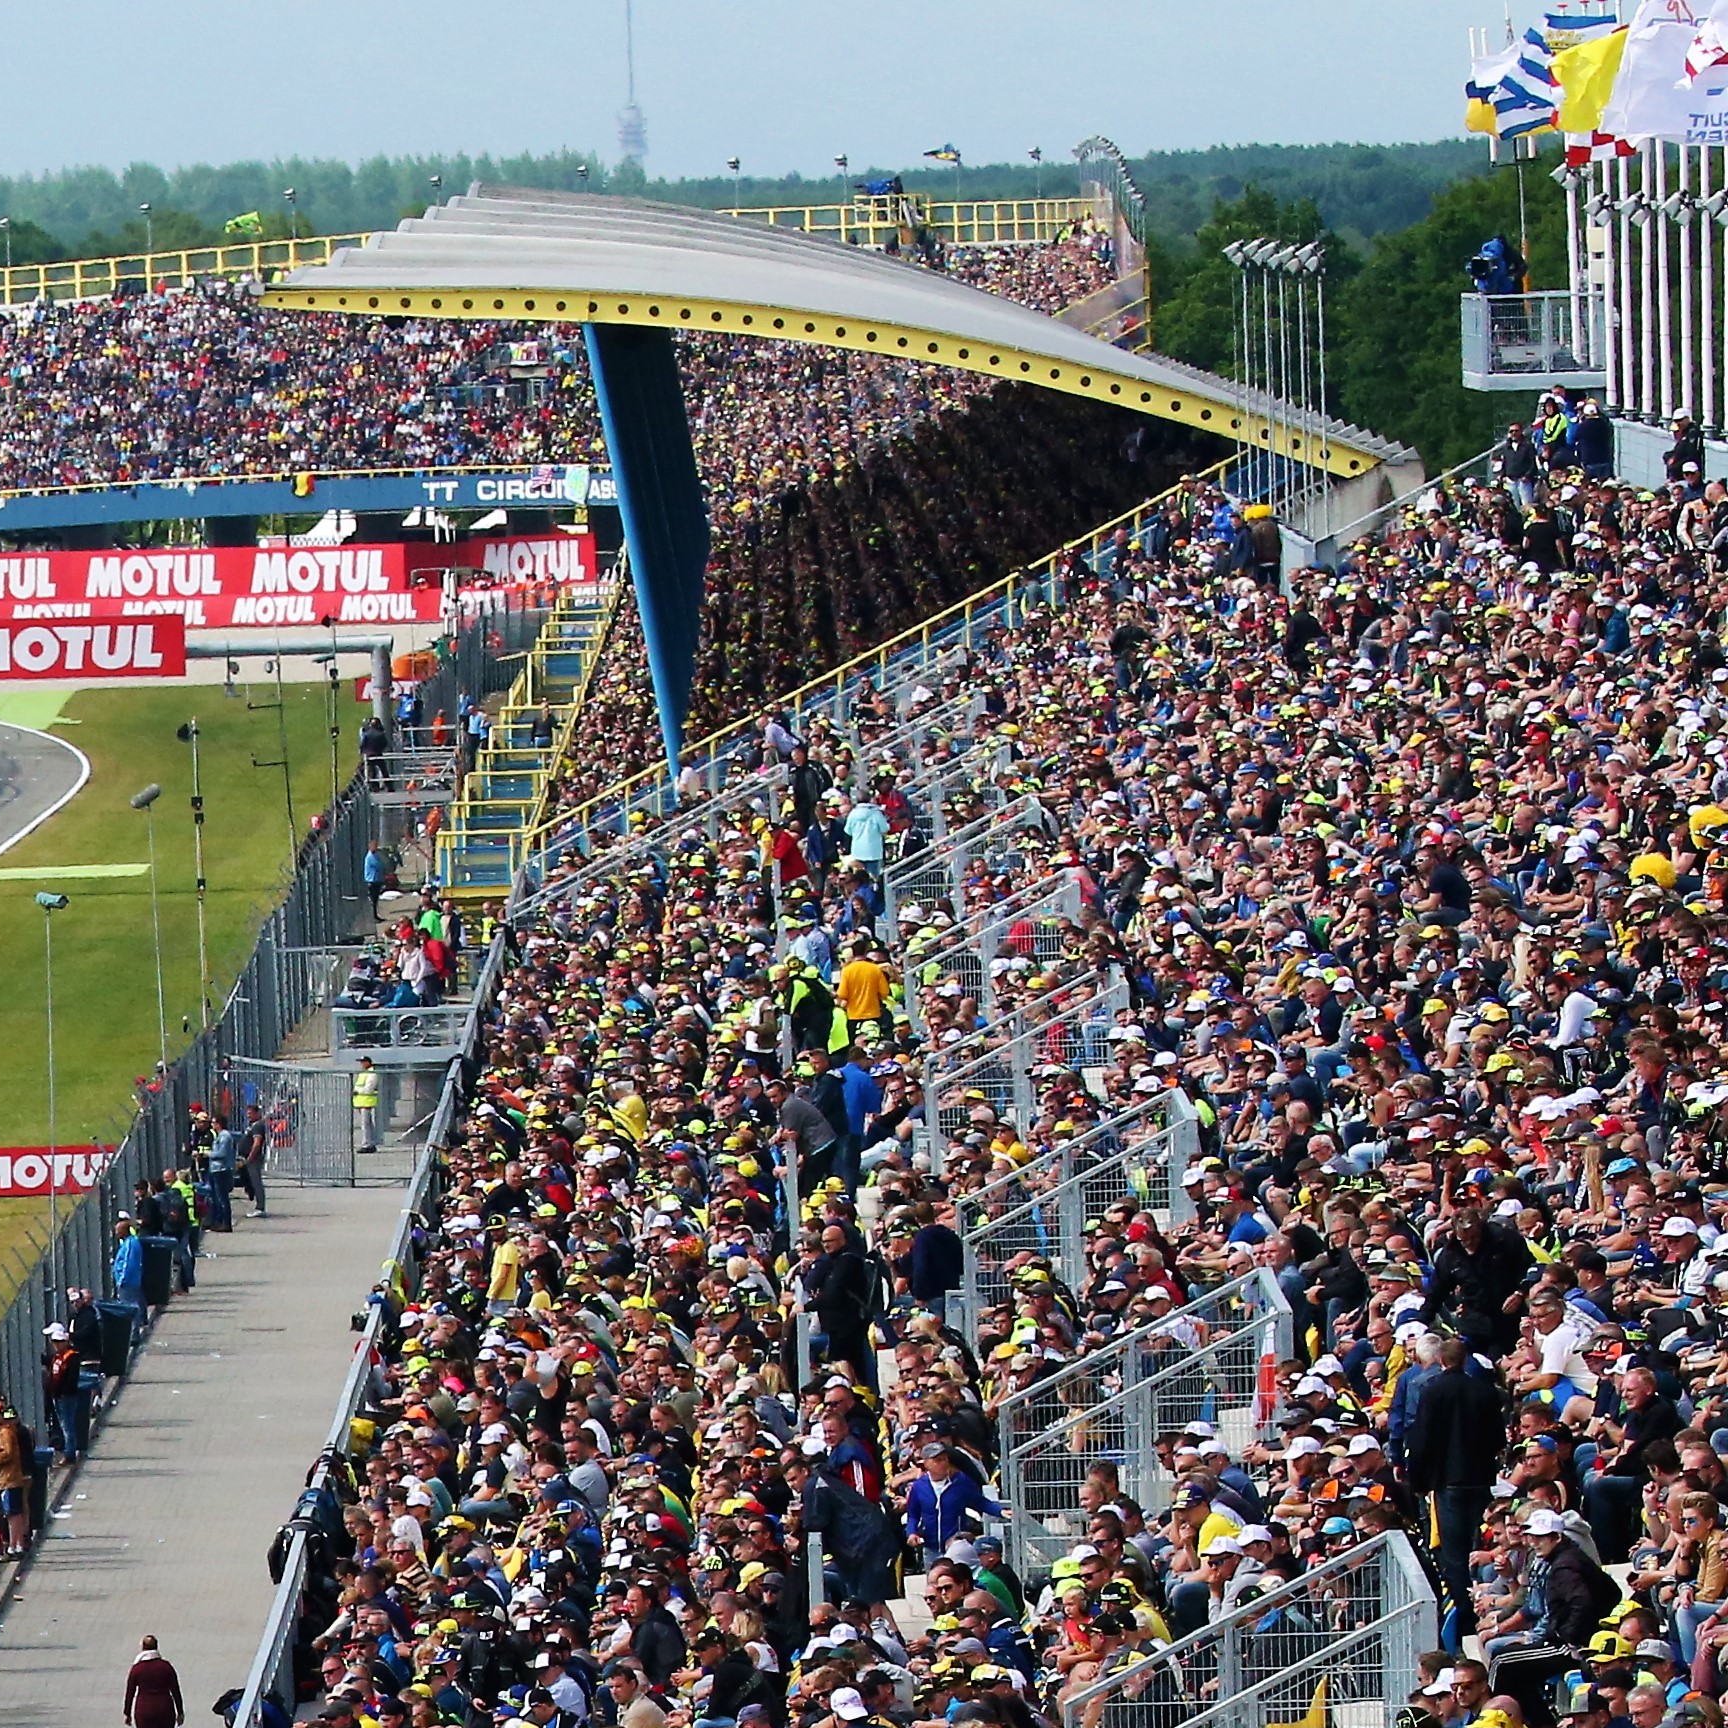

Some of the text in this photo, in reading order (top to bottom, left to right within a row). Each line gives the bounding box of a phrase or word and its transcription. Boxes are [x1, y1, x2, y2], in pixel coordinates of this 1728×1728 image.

[423, 481, 458, 501] TT
[477, 478, 565, 500] CIRCUI
[86, 554, 222, 598] MOTUL
[250, 550, 389, 594] MOTUL
[483, 540, 585, 583] MOTUL
[232, 596, 315, 624] MOTUL
[340, 594, 417, 621] MOTUL
